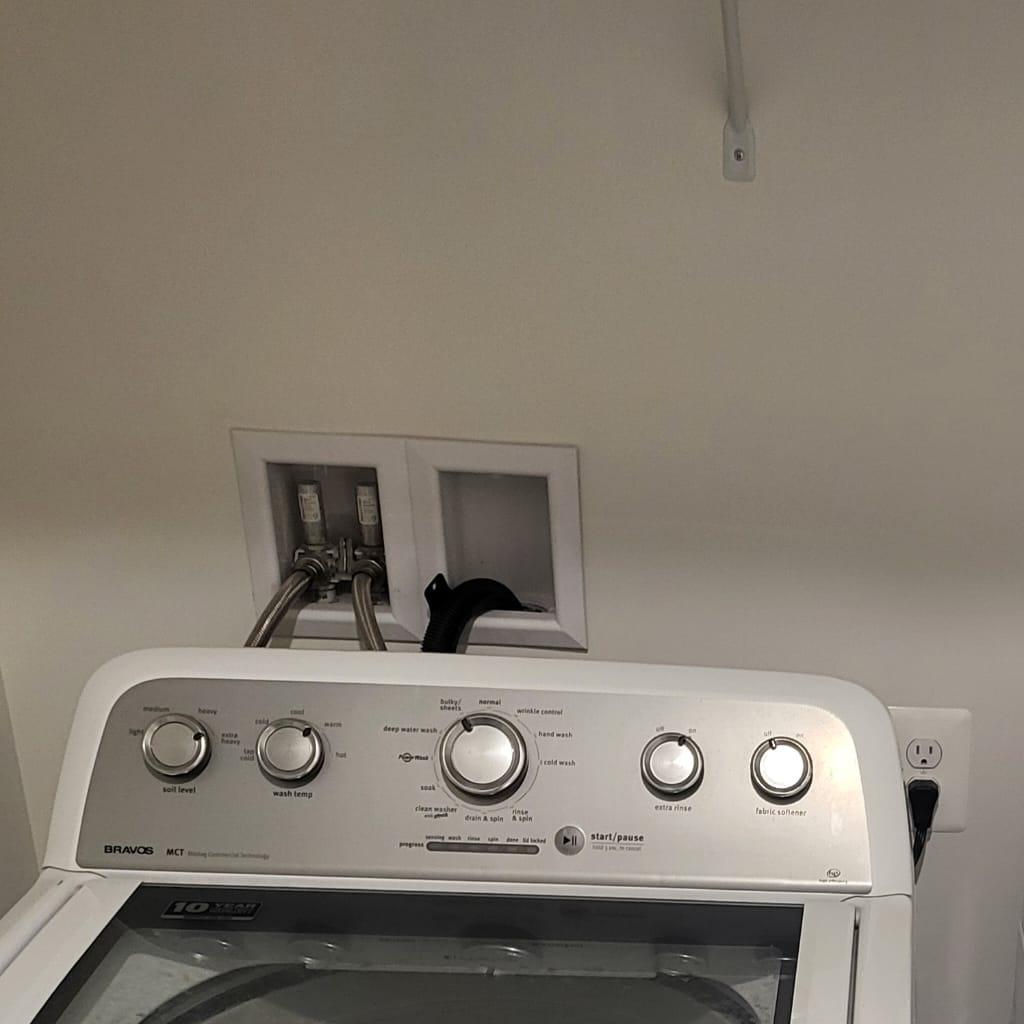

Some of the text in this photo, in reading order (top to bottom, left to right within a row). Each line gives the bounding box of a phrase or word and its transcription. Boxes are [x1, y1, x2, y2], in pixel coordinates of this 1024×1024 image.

[198, 707, 218, 716] heavy
[129, 728, 144, 736] light
[383, 725, 399, 733] deep
[221, 738, 240, 746] heavy
[162, 786, 196, 794] soil level
[420, 783, 436, 791] soak
[294, 790, 313, 799] temp
[673, 804, 692, 812] rinse
[755, 807, 808, 817] fabric softener
[465, 814, 482, 822] drain
[490, 815, 504, 823] spin
[518, 815, 533, 823] spin
[590, 832, 644, 844] start/pause
[104, 845, 154, 855] BRAVOS
[166, 848, 185, 857] MCT
[173, 902, 210, 913] 10
